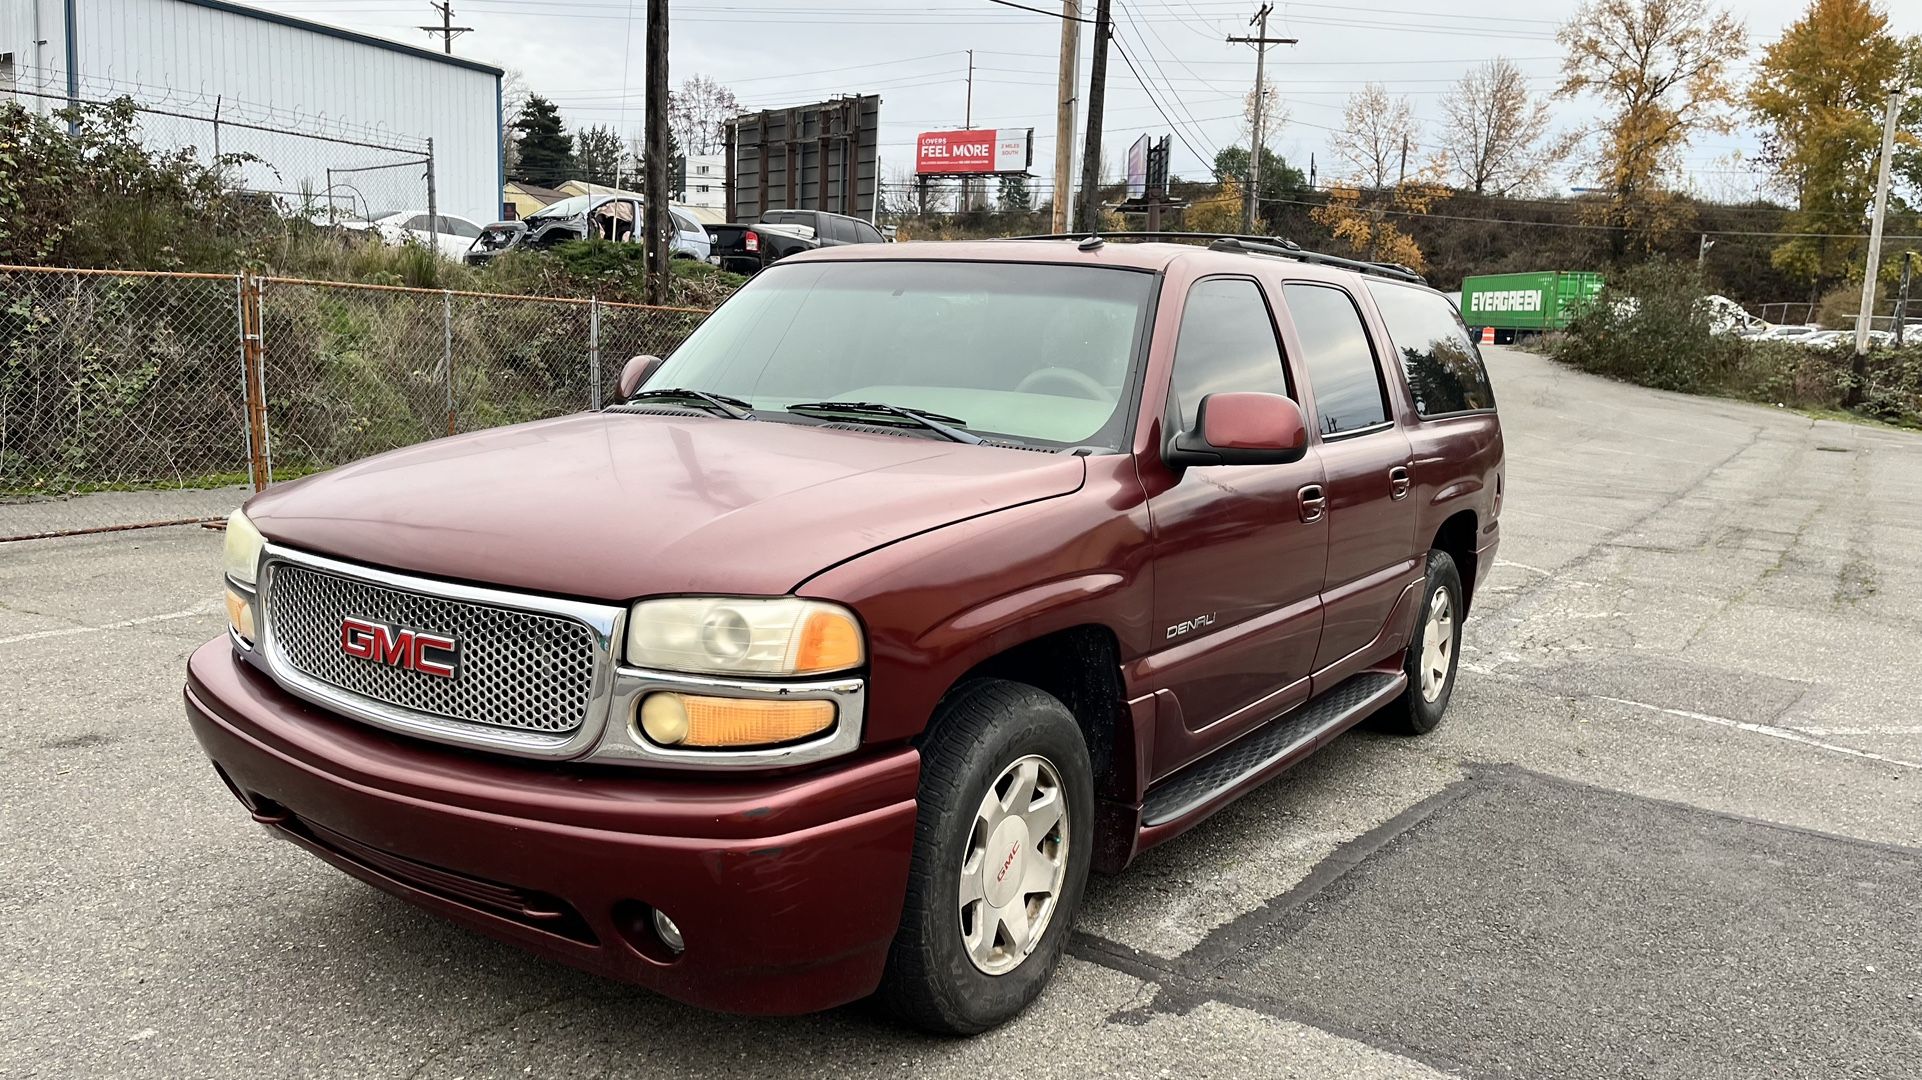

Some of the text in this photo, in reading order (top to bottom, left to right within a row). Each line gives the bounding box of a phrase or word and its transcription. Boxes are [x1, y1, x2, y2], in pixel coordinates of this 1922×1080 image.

[921, 144, 989, 158] FEEL MORE
[922, 137, 947, 146] LOVERS
[1471, 289, 1542, 312] EVERGREEN
[1166, 611, 1216, 639] DENALI
[341, 616, 456, 679] GMC
[997, 839, 1020, 882] GMC
